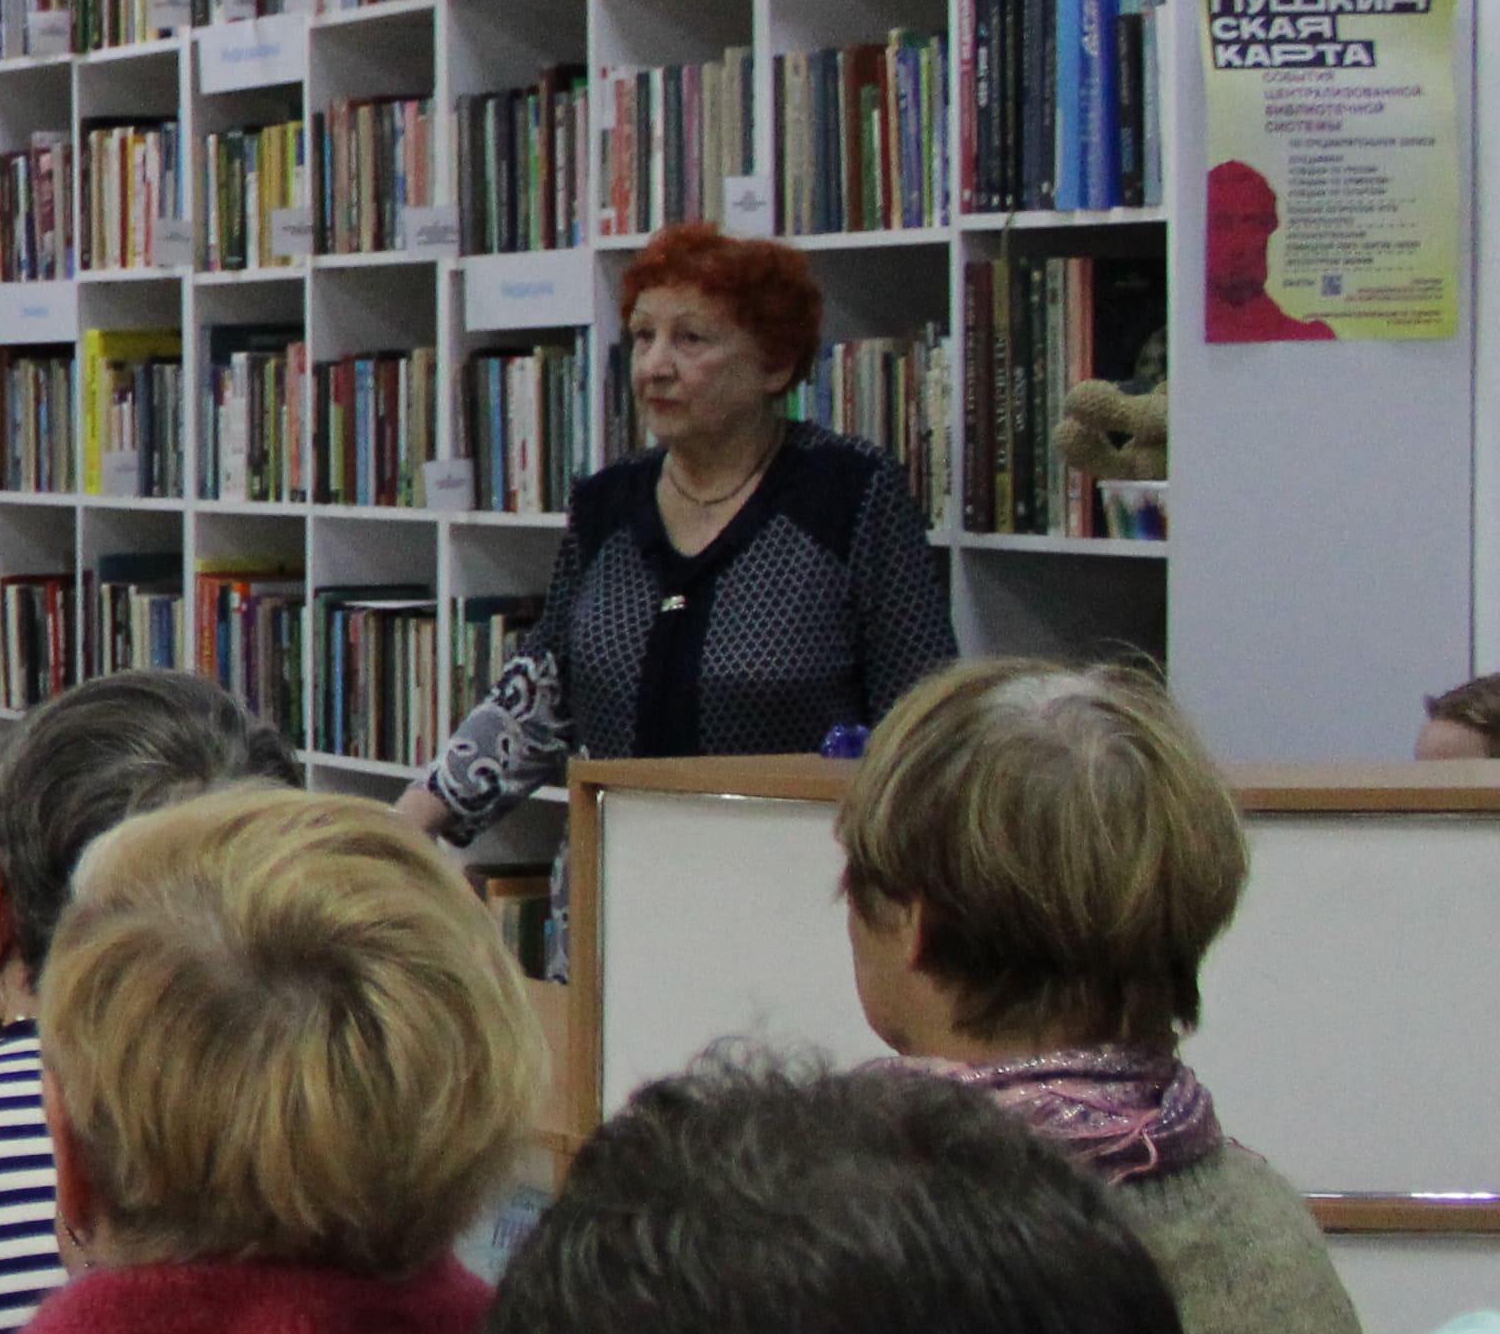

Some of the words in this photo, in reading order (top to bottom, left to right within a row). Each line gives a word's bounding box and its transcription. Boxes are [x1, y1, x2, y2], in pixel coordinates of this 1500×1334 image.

[1211, 16, 1334, 40] СКАЯ
[1217, 43, 1373, 66] КАРТА
[1262, 71, 1335, 83] СОБЫТИЯ
[1265, 102, 1385, 117] БИБЛИОТЕЧНОЙ
[1265, 120, 1343, 133] СИСТЕМЫ
